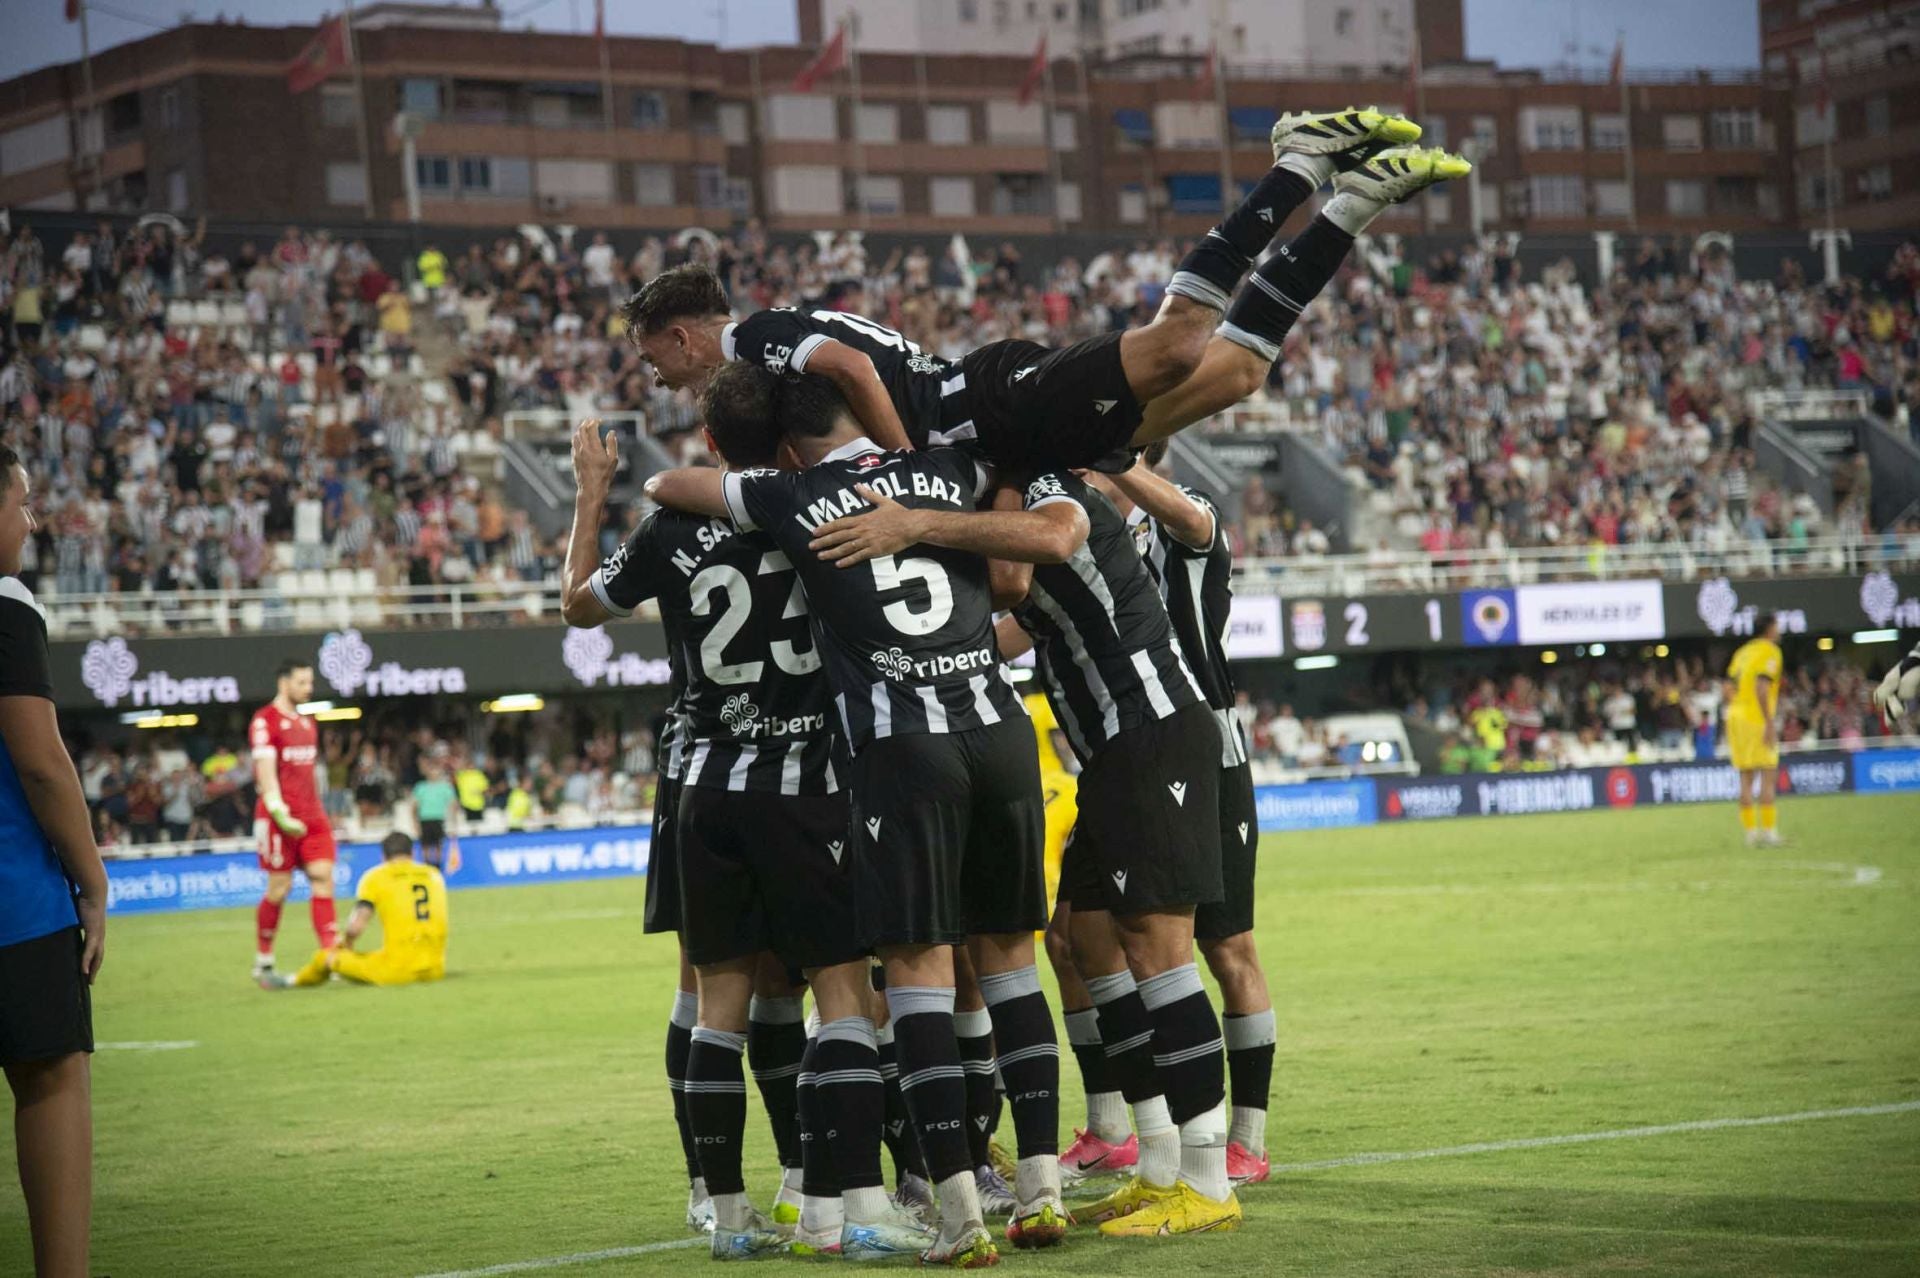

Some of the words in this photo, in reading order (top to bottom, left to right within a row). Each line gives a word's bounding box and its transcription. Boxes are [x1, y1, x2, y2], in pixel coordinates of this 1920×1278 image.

[671, 548, 702, 577] N.
[696, 518, 733, 552] SA
[870, 554, 954, 635] 5
[689, 550, 823, 686] 23
[1344, 602, 1370, 646] 2
[1424, 599, 1442, 642] 1
[1732, 605, 1807, 636] rira
[365, 662, 467, 697] ribera
[607, 652, 671, 687] ribe
[914, 648, 994, 678] ribera
[131, 671, 240, 706] ribera
[490, 838, 650, 877] www.esp
[107, 869, 178, 908] pacio
[412, 884, 430, 920] 2
[694, 1135, 727, 1145] FCC
[925, 1119, 961, 1132] FCC
